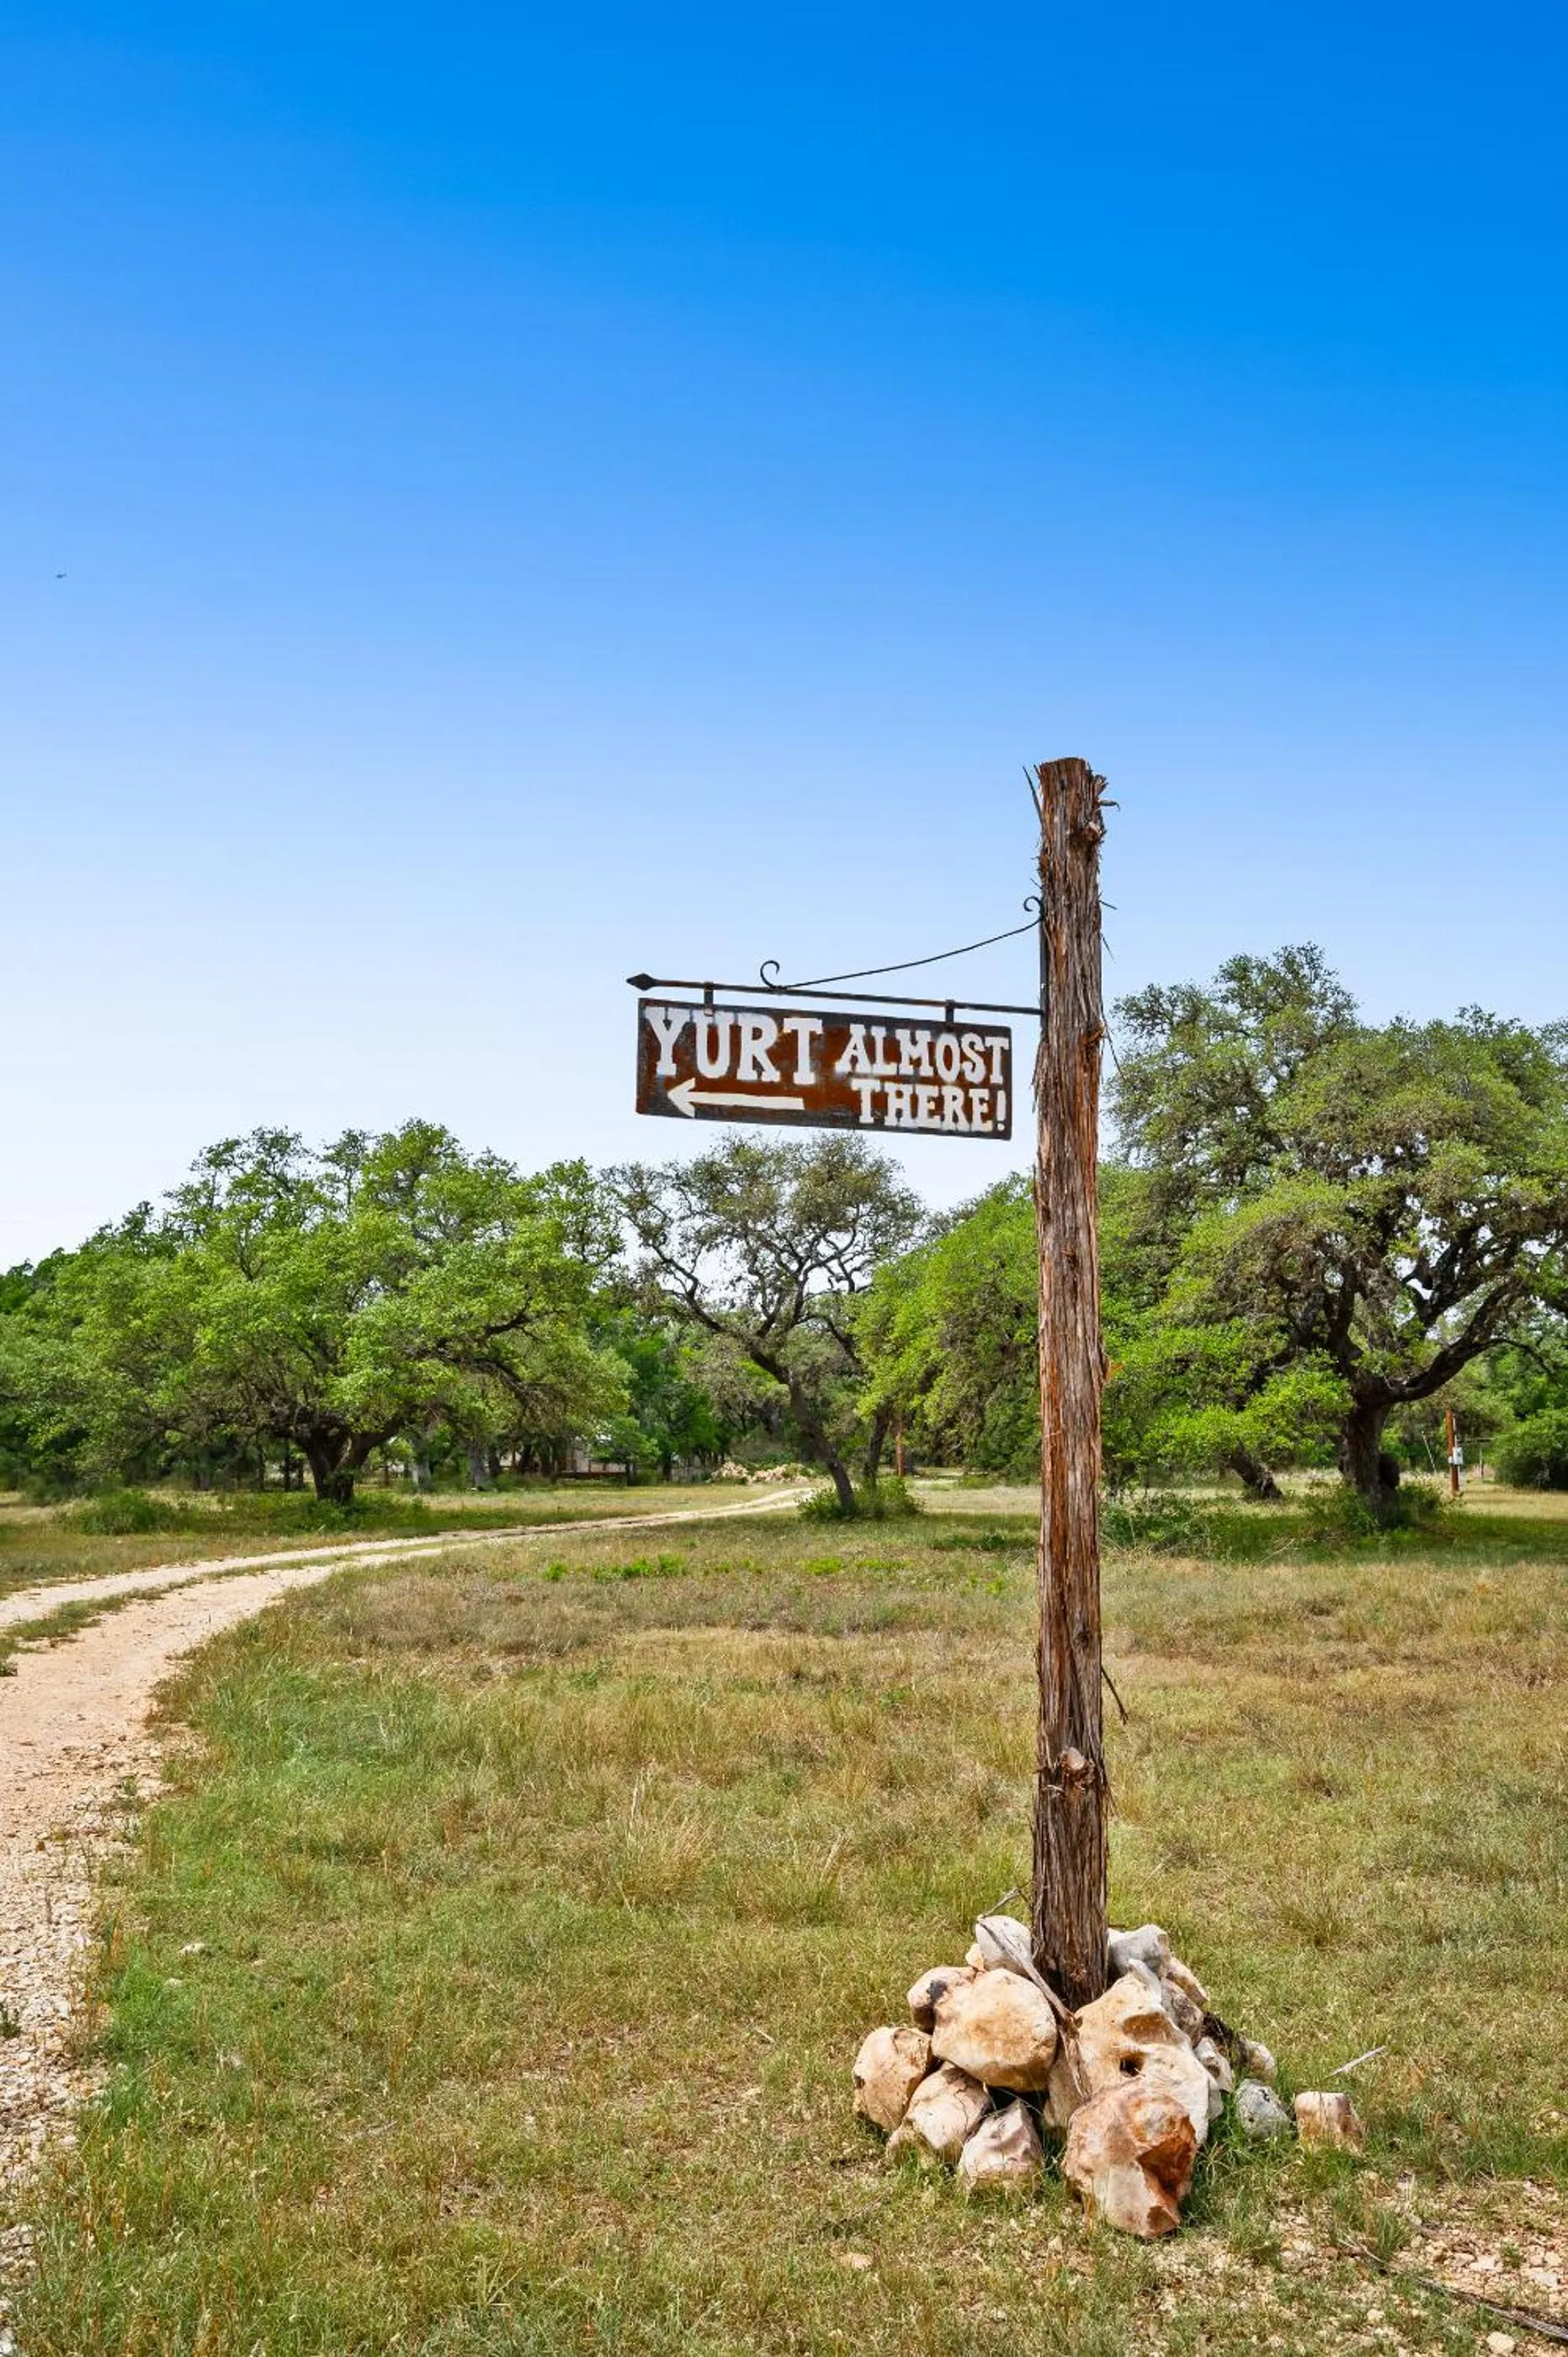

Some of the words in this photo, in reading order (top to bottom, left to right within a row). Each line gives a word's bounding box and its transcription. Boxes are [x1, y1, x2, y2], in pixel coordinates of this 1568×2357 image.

[645, 1007, 822, 1085] YURT
[835, 1024, 1009, 1085] ALMOST
[852, 1078, 1007, 1131] THERE!
